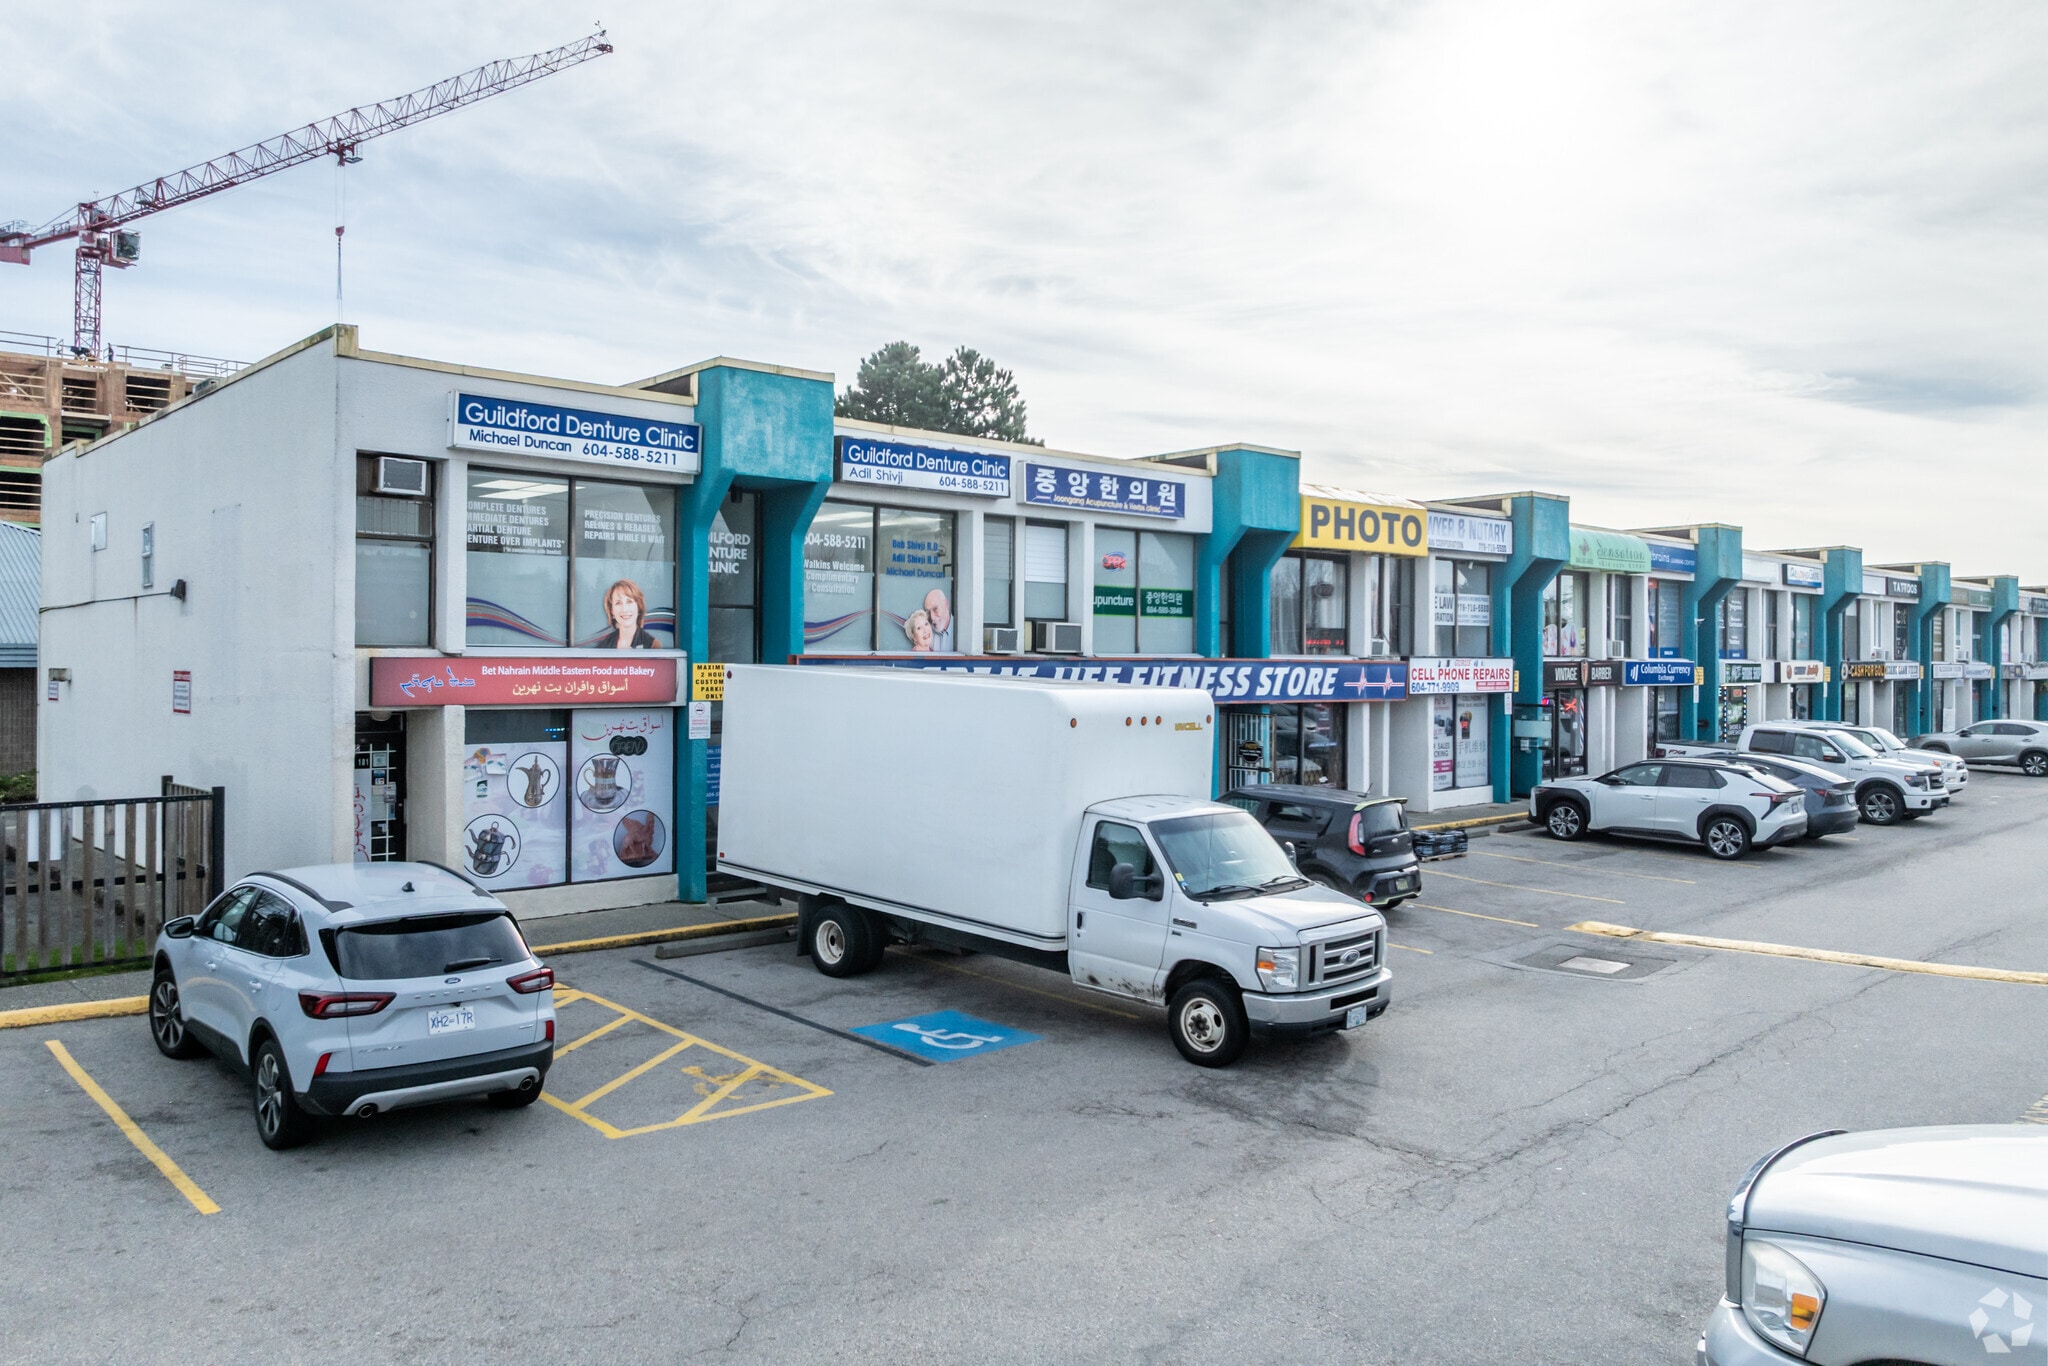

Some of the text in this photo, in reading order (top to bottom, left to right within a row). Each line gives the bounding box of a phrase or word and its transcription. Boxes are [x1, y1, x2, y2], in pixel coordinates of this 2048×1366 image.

[465, 402, 694, 449] Guildford Denture Clinic
[469, 428, 677, 465] Michael Duncan 604-588-5211
[848, 445, 1006, 477] Guildford Denture Clinic
[849, 467, 1005, 492] Adil Shivji 604-588-5211
[467, 501, 547, 515] OMPLETE DENTURES
[1086, 498, 1123, 509] Acupuncture
[509, 515, 549, 526] DENTURES
[584, 509, 661, 523] PRECISION DENTURES
[467, 523, 532, 535] ARTIAL DENTURE
[584, 520, 656, 533] RELINES & REBASES
[1311, 504, 1422, 547] PHOTO
[1428, 516, 1506, 542] WYER & NOTARY
[467, 534, 498, 544] ENTURE
[500, 536, 520, 546] OVER
[584, 530, 665, 544] REPAIRS WHILE U WAIT
[709, 532, 751, 545] ILFORD
[892, 539, 905, 549] Bob
[907, 541, 926, 551] Shivji
[709, 547, 748, 560] NTURE
[892, 553, 905, 563] Adil
[907, 554, 926, 565] Shivji
[1651, 551, 1670, 563] brains
[832, 561, 865, 572] Welcome
[886, 566, 945, 578] Michael Duncan
[812, 583, 855, 594] Consultation
[1893, 581, 1917, 594] TATTOOS
[1093, 595, 1134, 607] upuncture
[1439, 596, 1454, 609] LAW
[482, 666, 655, 677] Bet Nahrain Middle Eastern Food and Bakery
[1411, 668, 1510, 680] CELL PHONE REPAIRS
[1555, 667, 1612, 681] VINTAGE BARBER
[1640, 664, 1691, 676] Columbia Currency
[1851, 665, 1865, 677] CASH
[1865, 665, 1874, 677] FOR
[512, 678, 629, 696] أسواق وافران بت نهرين
[1130, 666, 1250, 697] FITNESS
[1256, 666, 1339, 697] STORE
[1411, 682, 1460, 692] 604-771-9909
[611, 739, 644, 754] OPEN
[358, 758, 369, 766] 101
